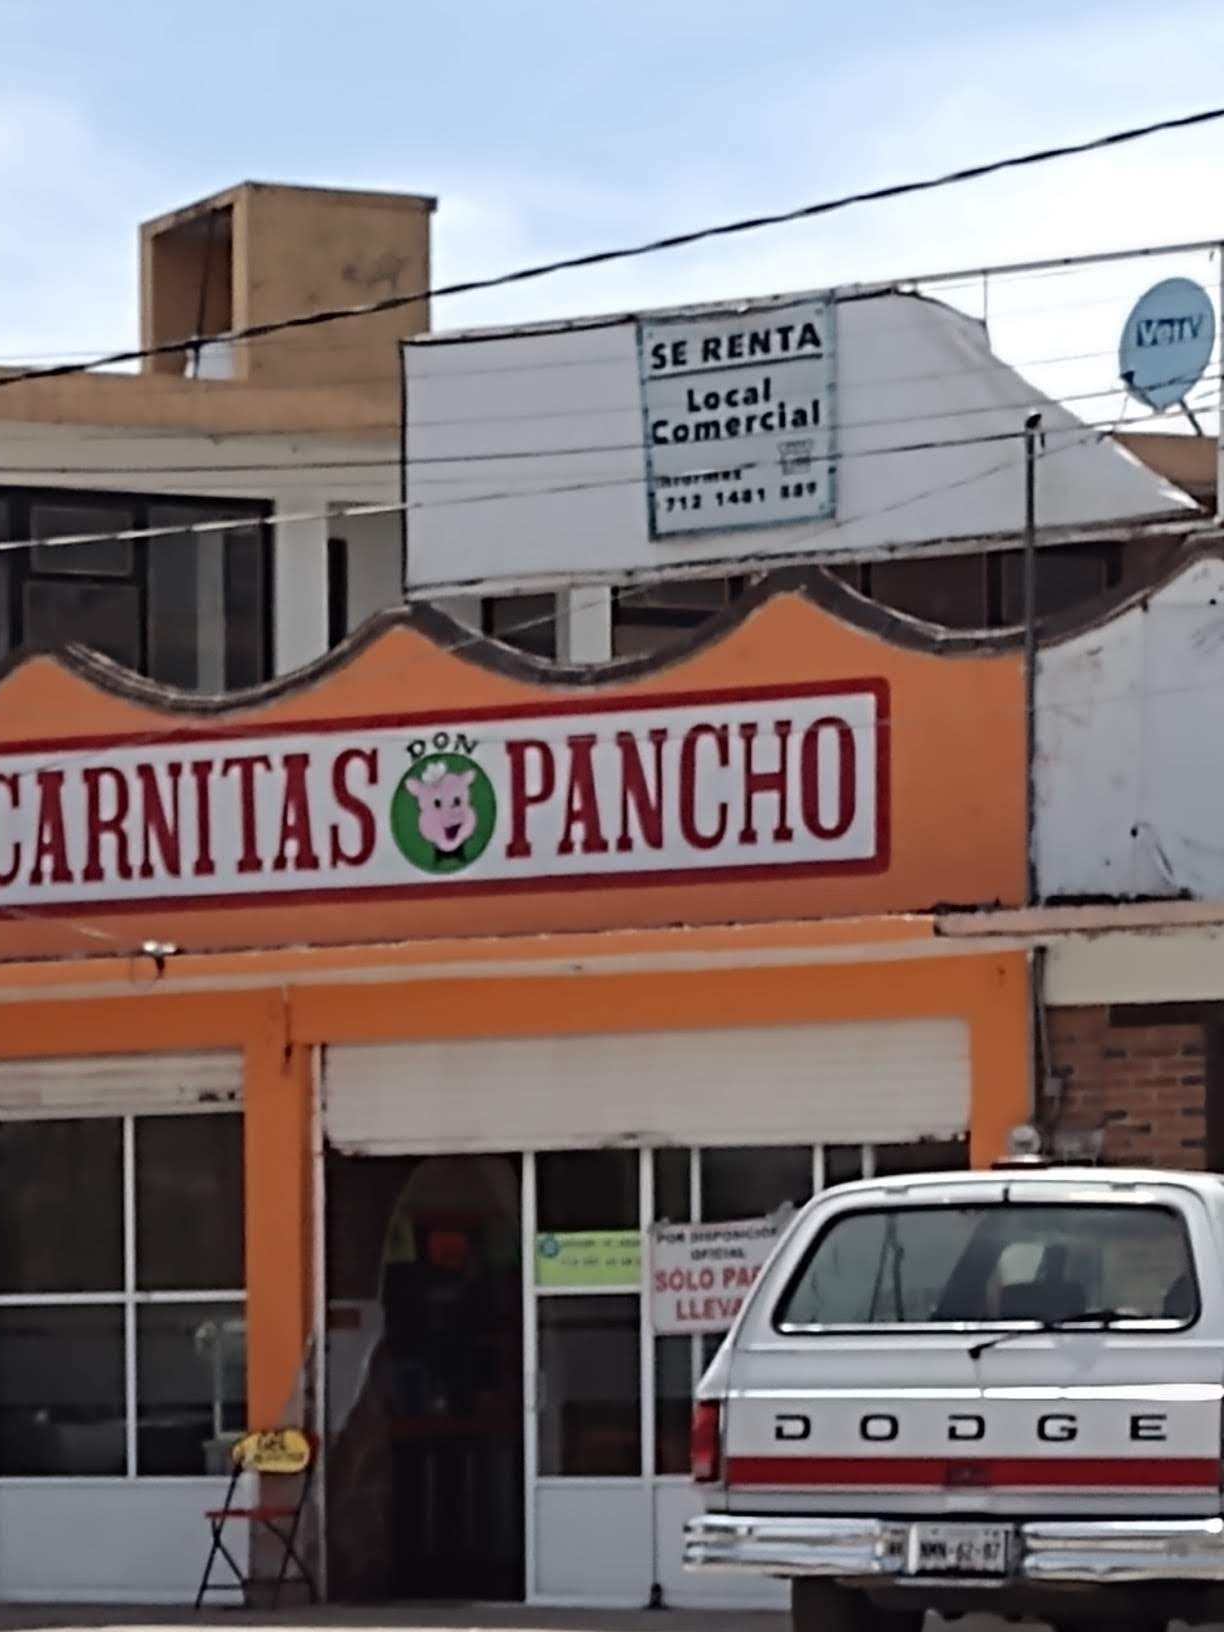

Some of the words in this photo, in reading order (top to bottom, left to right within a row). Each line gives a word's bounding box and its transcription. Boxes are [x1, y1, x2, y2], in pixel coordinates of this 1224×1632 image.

[651, 342, 687, 370] SE
[702, 322, 821, 363] RENTA
[687, 377, 771, 413] Local
[652, 399, 819, 445] Comercial
[406, 731, 479, 761] DON
[505, 716, 856, 858] PANCHO
[774, 1413, 1168, 1442] DODGE
